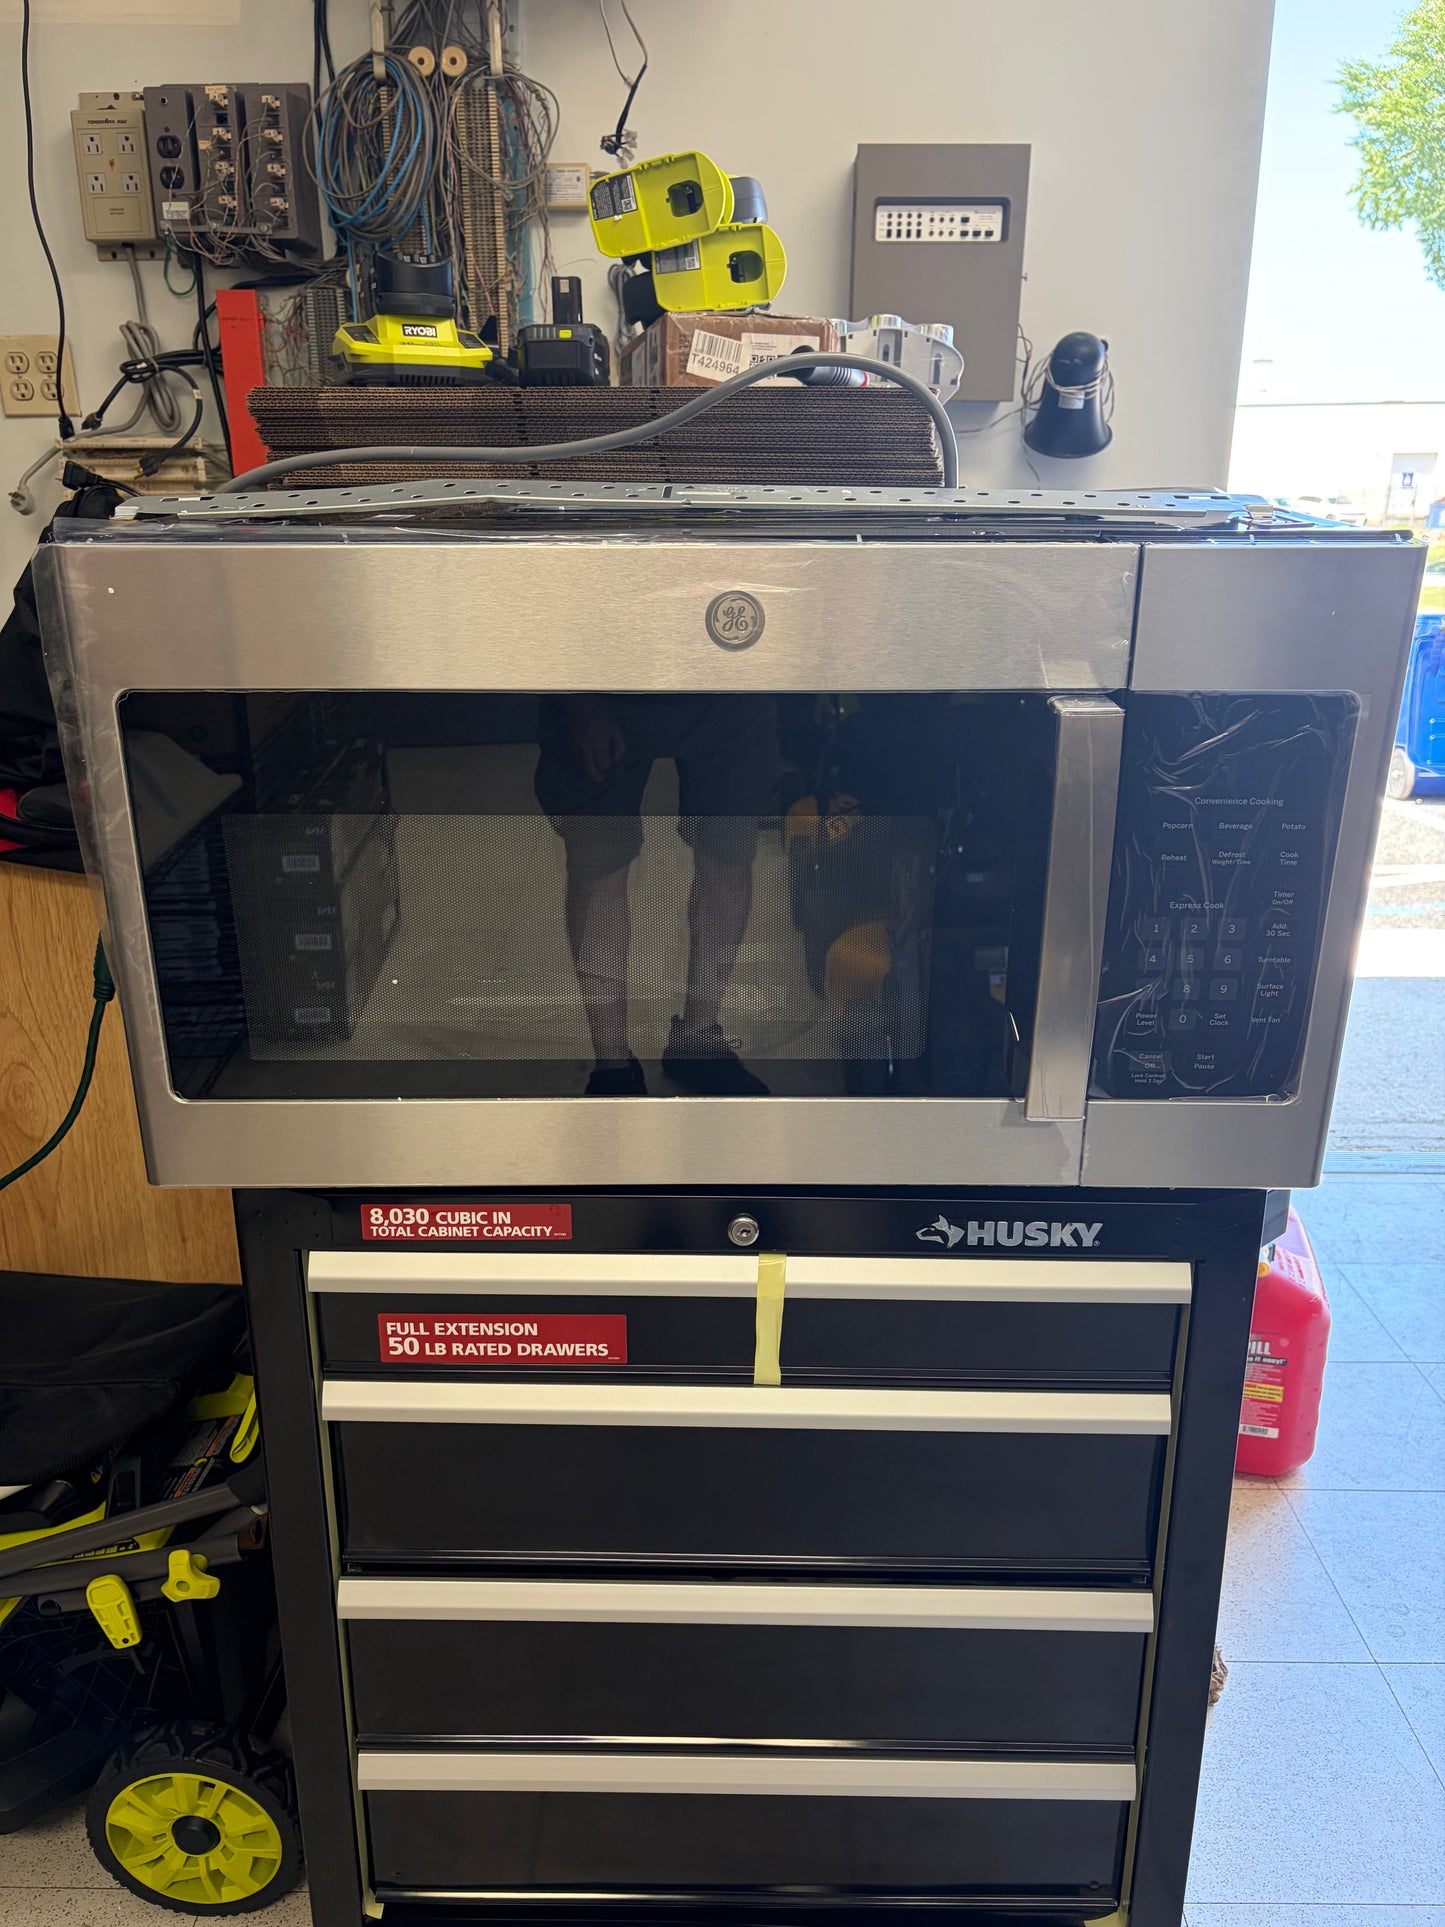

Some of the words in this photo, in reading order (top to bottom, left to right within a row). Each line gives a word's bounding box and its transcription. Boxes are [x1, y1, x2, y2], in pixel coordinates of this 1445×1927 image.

[403, 325, 437, 337] RYOBI
[691, 352, 740, 375] T424964
[1194, 796, 1248, 806] Convenience
[1250, 797, 1284, 808] Cooking
[1162, 822, 1194, 830] Popcorn
[1219, 822, 1253, 831] Beverage
[1281, 822, 1306, 830] Potato
[1218, 851, 1246, 859] Defrost
[1280, 851, 1299, 859] Cook
[1273, 890, 1295, 898] Timer
[1169, 901, 1201, 911] Express
[1203, 901, 1224, 910] Cook
[1153, 924, 1159, 933] 1
[1190, 924, 1198, 933] 2
[1228, 924, 1236, 934] 3
[1271, 922, 1287, 930] Add
[1148, 954, 1157, 963] 4
[1186, 954, 1194, 963] 5
[1224, 954, 1232, 964] 6
[1258, 956, 1291, 964] Turntable
[1183, 984, 1191, 994] 8
[1220, 984, 1228, 994] 9
[1256, 982, 1285, 990] Surface
[1260, 990, 1279, 998] Light
[1179, 1014, 1187, 1024] 0
[1209, 1019, 1229, 1027] Clock
[1250, 1016, 1267, 1024] Vent
[1268, 1016, 1281, 1024] Fan
[1196, 1053, 1215, 1061] Start
[369, 1207, 430, 1228] 8,030
[435, 1211, 489, 1225] CUBIC
[492, 1211, 511, 1225] IN
[370, 1226, 415, 1237] TOTAL
[418, 1226, 480, 1237] CABINET
[482, 1226, 553, 1237] CAPACITY
[967, 1221, 1104, 1248] HUSKY
[386, 1322, 430, 1335] FULL
[434, 1322, 539, 1336] EXTENSION
[388, 1337, 420, 1356] 50
[425, 1343, 447, 1356] LB
[451, 1343, 512, 1356] RATED
[517, 1343, 609, 1357] DRAWERS
